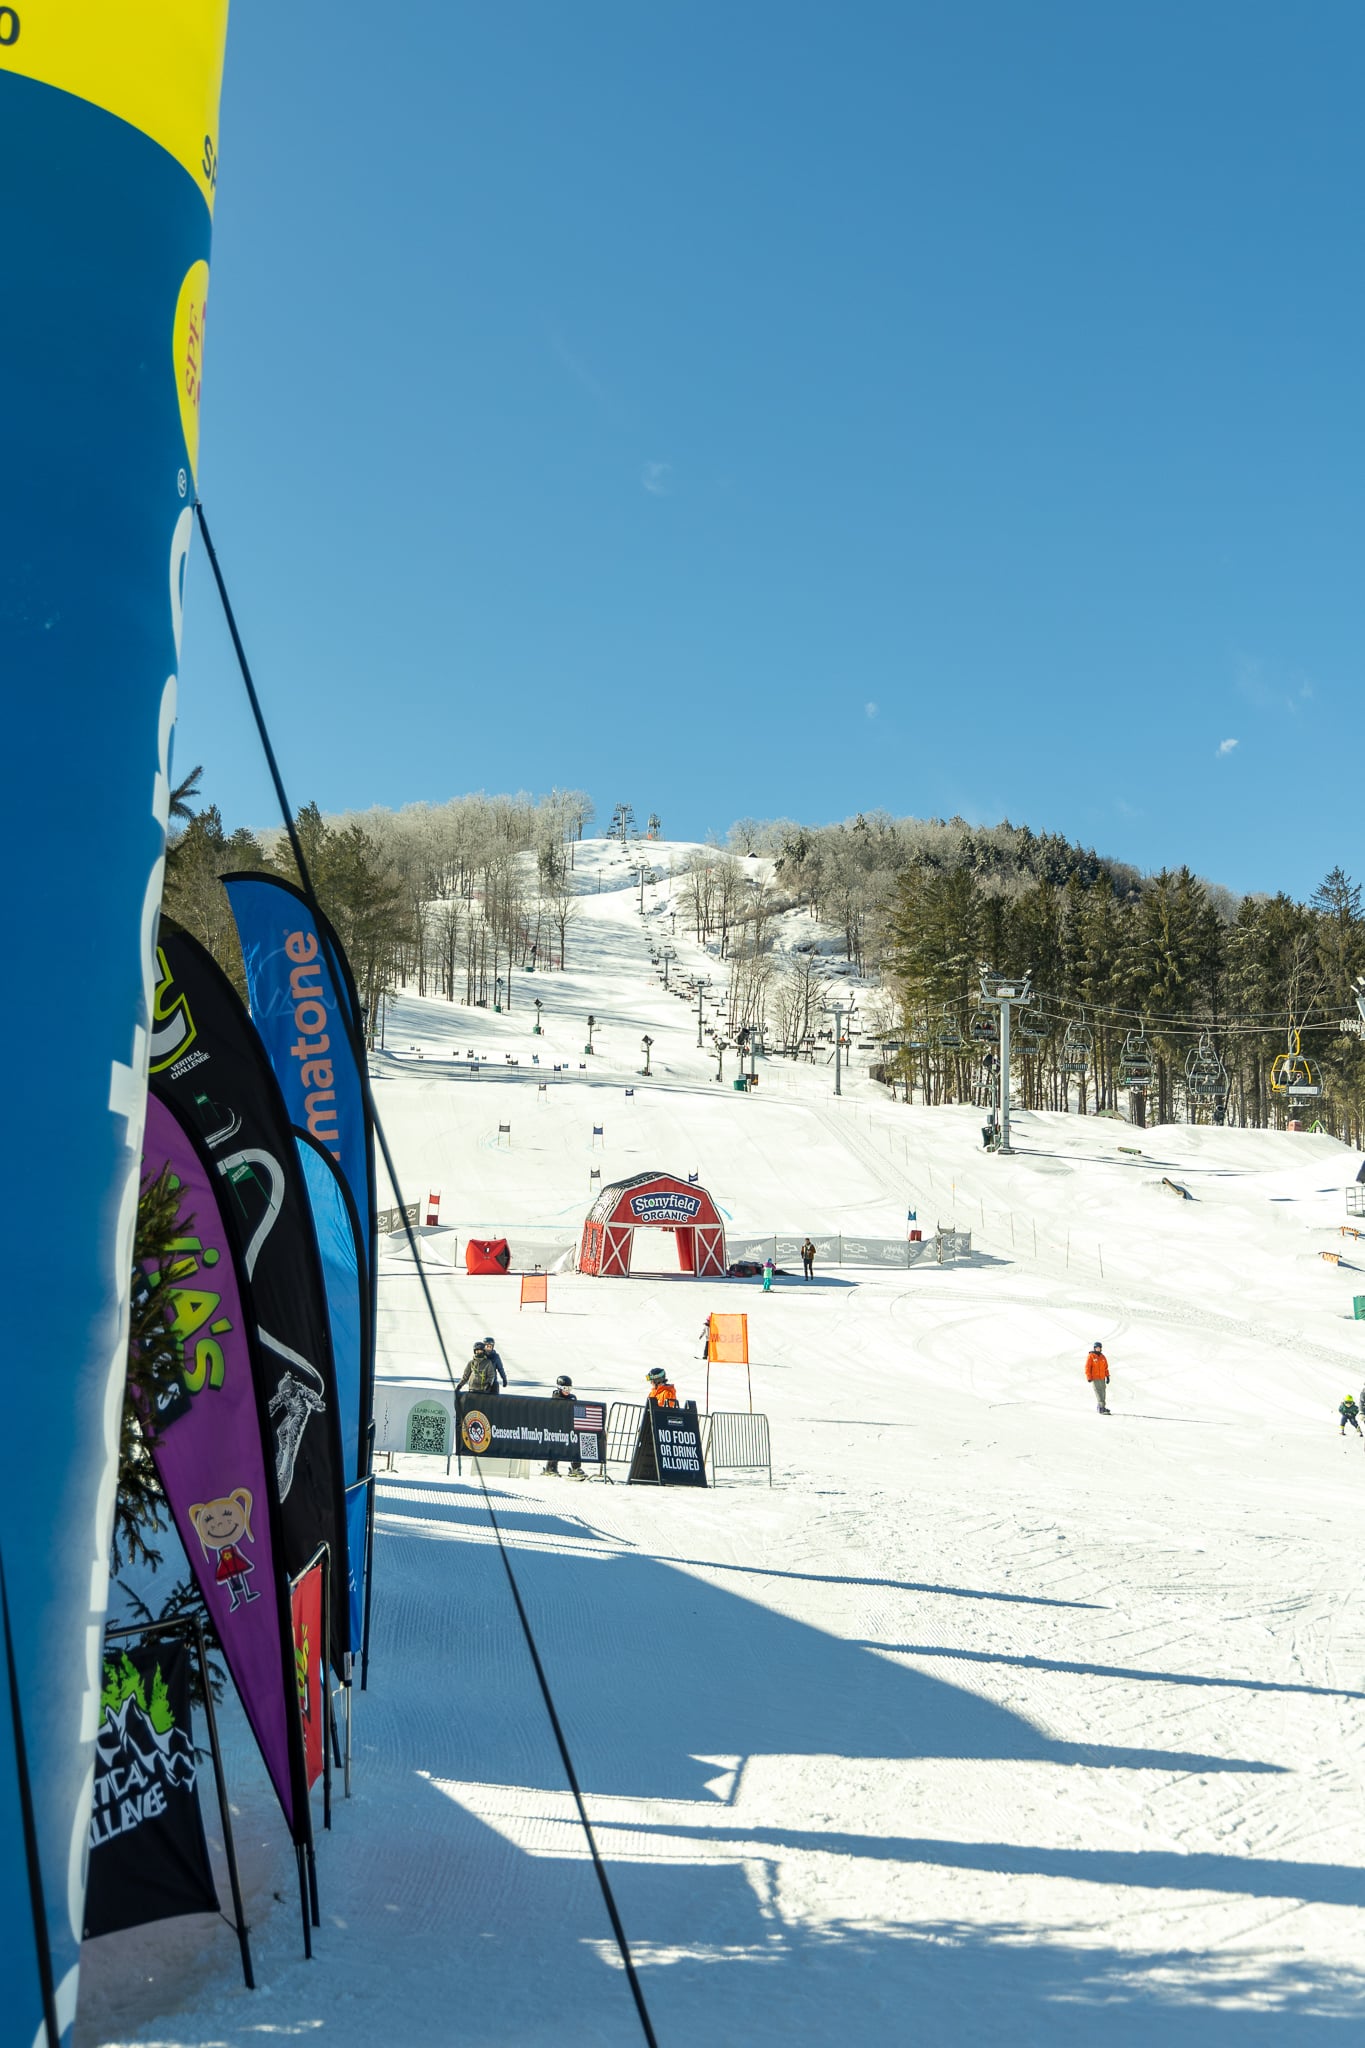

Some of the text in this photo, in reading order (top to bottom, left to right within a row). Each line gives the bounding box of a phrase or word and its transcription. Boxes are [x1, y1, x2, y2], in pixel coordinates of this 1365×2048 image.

[285, 930, 340, 1161] matone
[170, 1050, 204, 1072] VERTICAL
[170, 1052, 211, 1080] CHALLENGE
[635, 1194, 696, 1212] Stonyfield
[642, 1211, 688, 1222] ORGANIC
[491, 1424, 578, 1446] Censored Munky Brewing Co
[658, 1429, 696, 1445] NO FOOD
[660, 1444, 699, 1459] OR DRINK
[662, 1457, 700, 1471] ALLOWED
